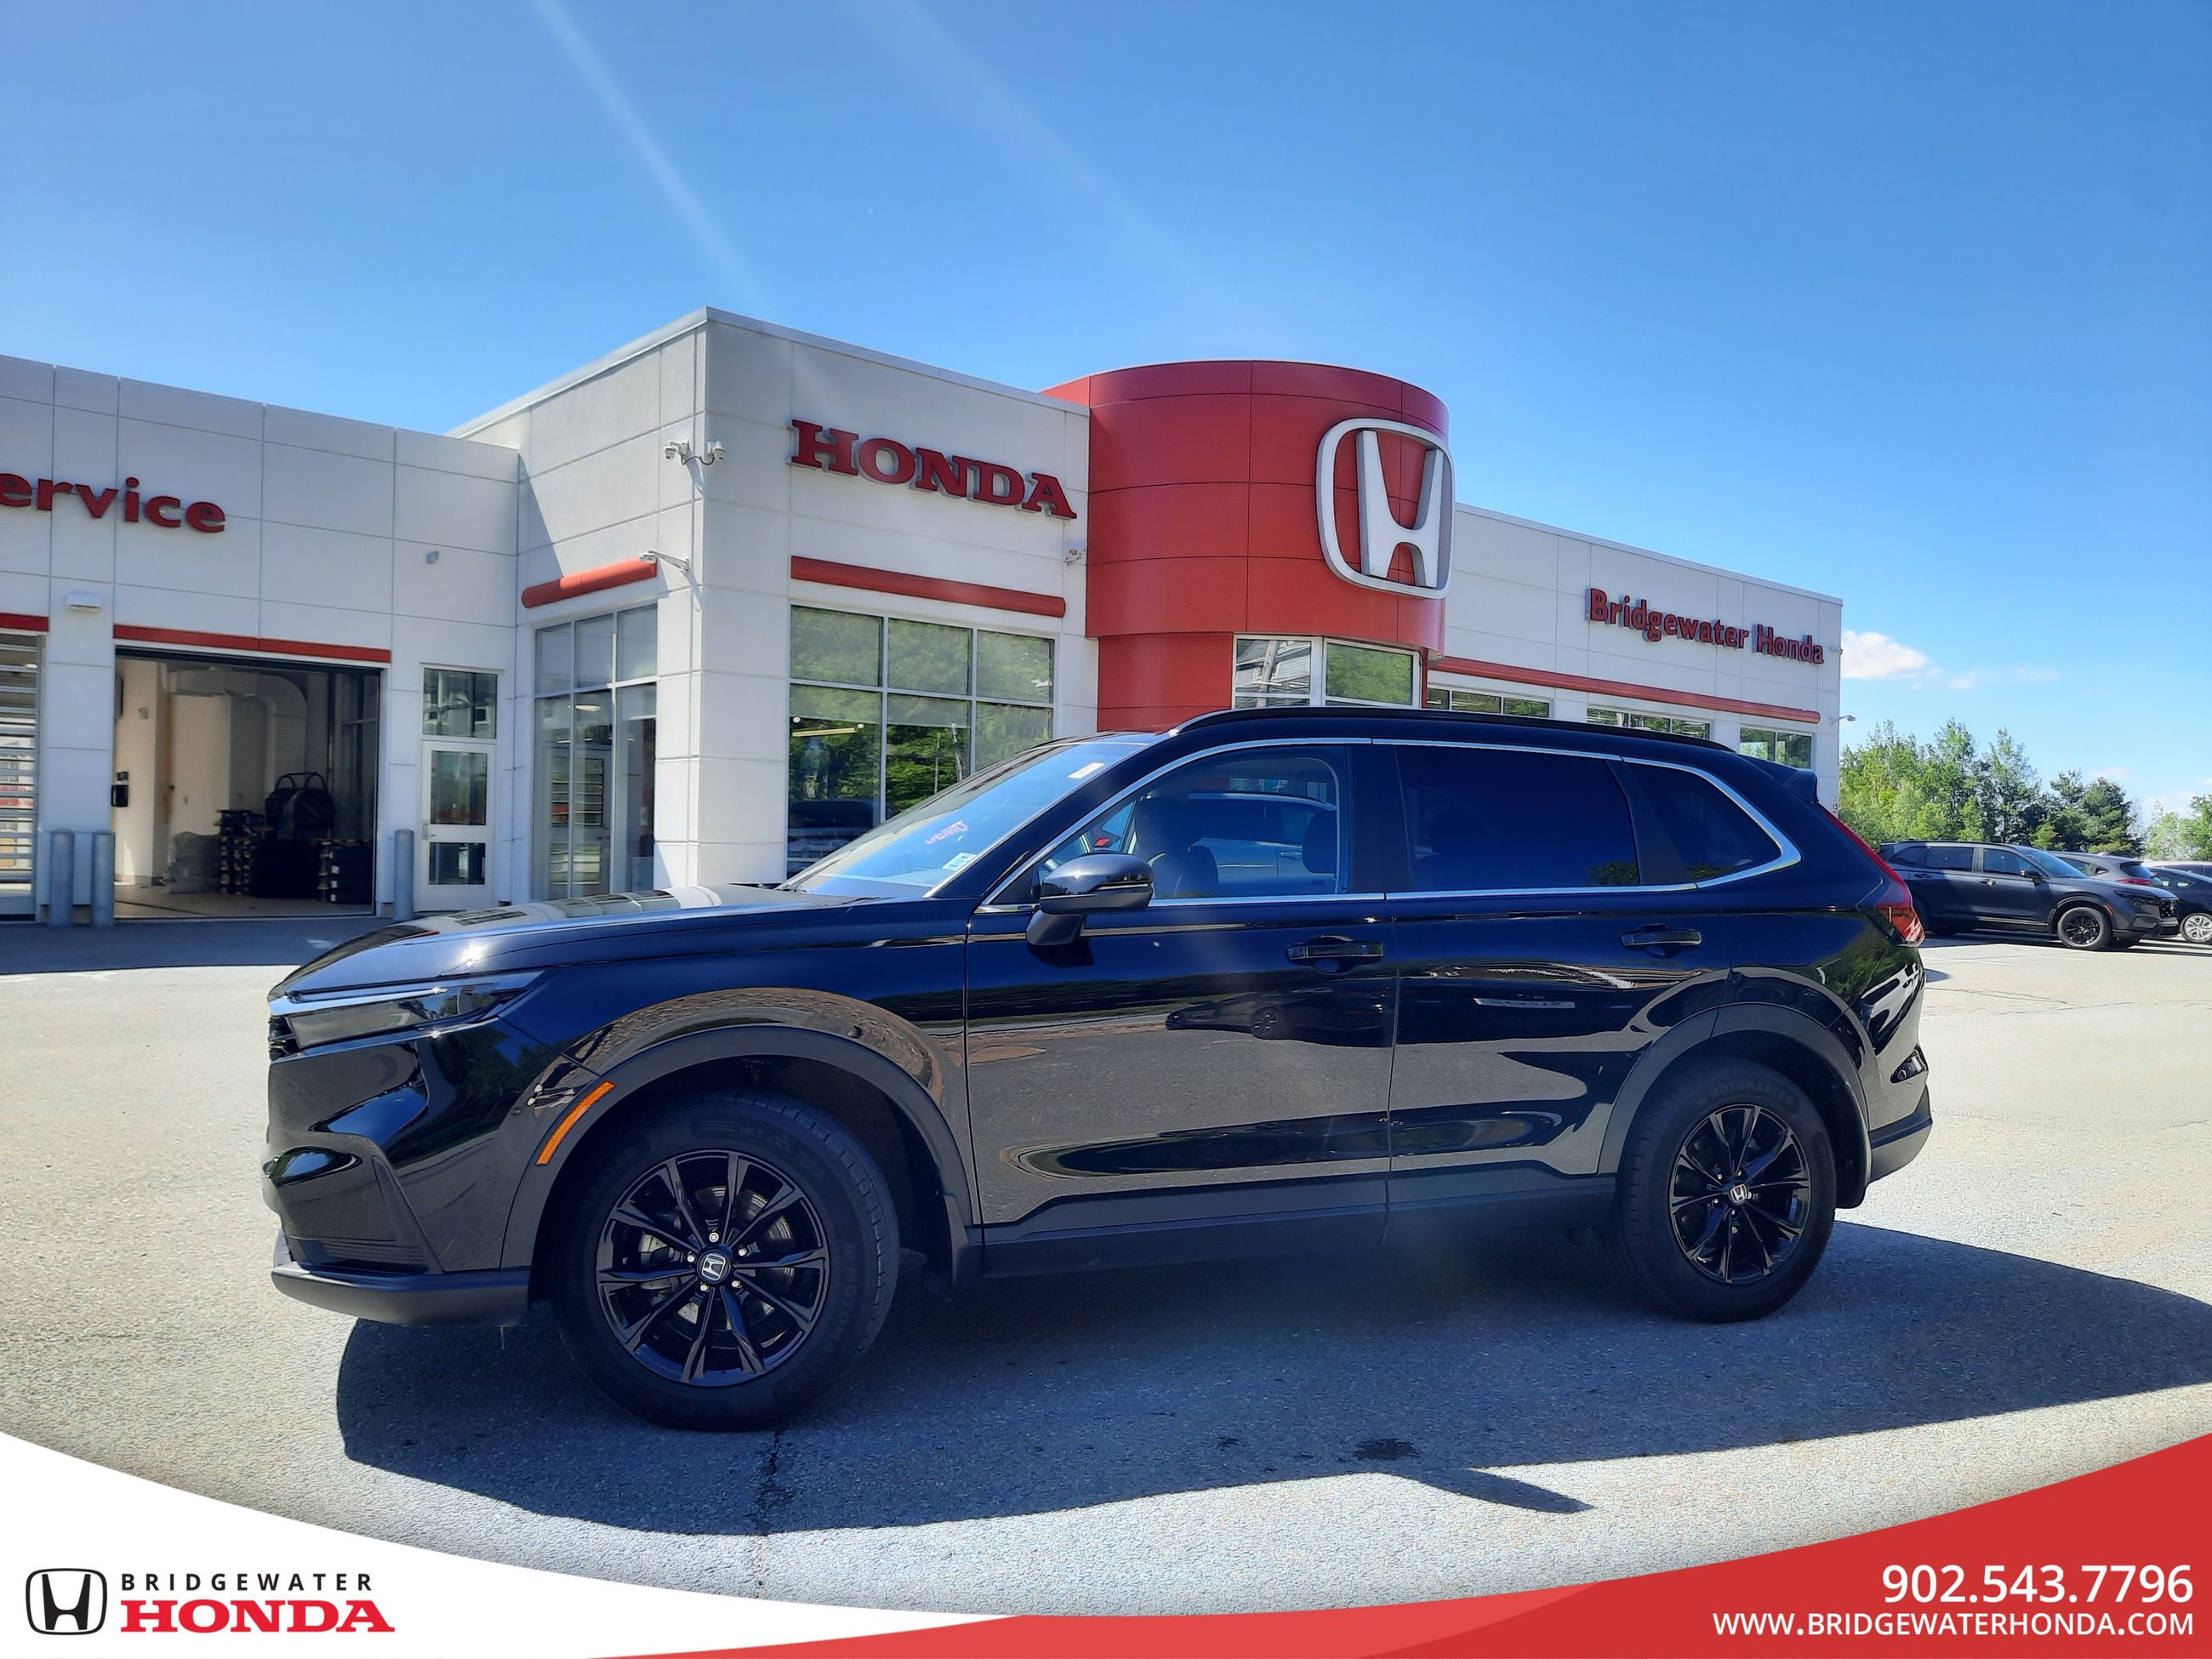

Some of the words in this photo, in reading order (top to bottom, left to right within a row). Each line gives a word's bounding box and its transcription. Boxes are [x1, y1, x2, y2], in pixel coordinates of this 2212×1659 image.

[790, 419, 1077, 520] HONDA
[1588, 587, 1749, 649] Bridgewater
[1756, 624, 1825, 664] Honda
